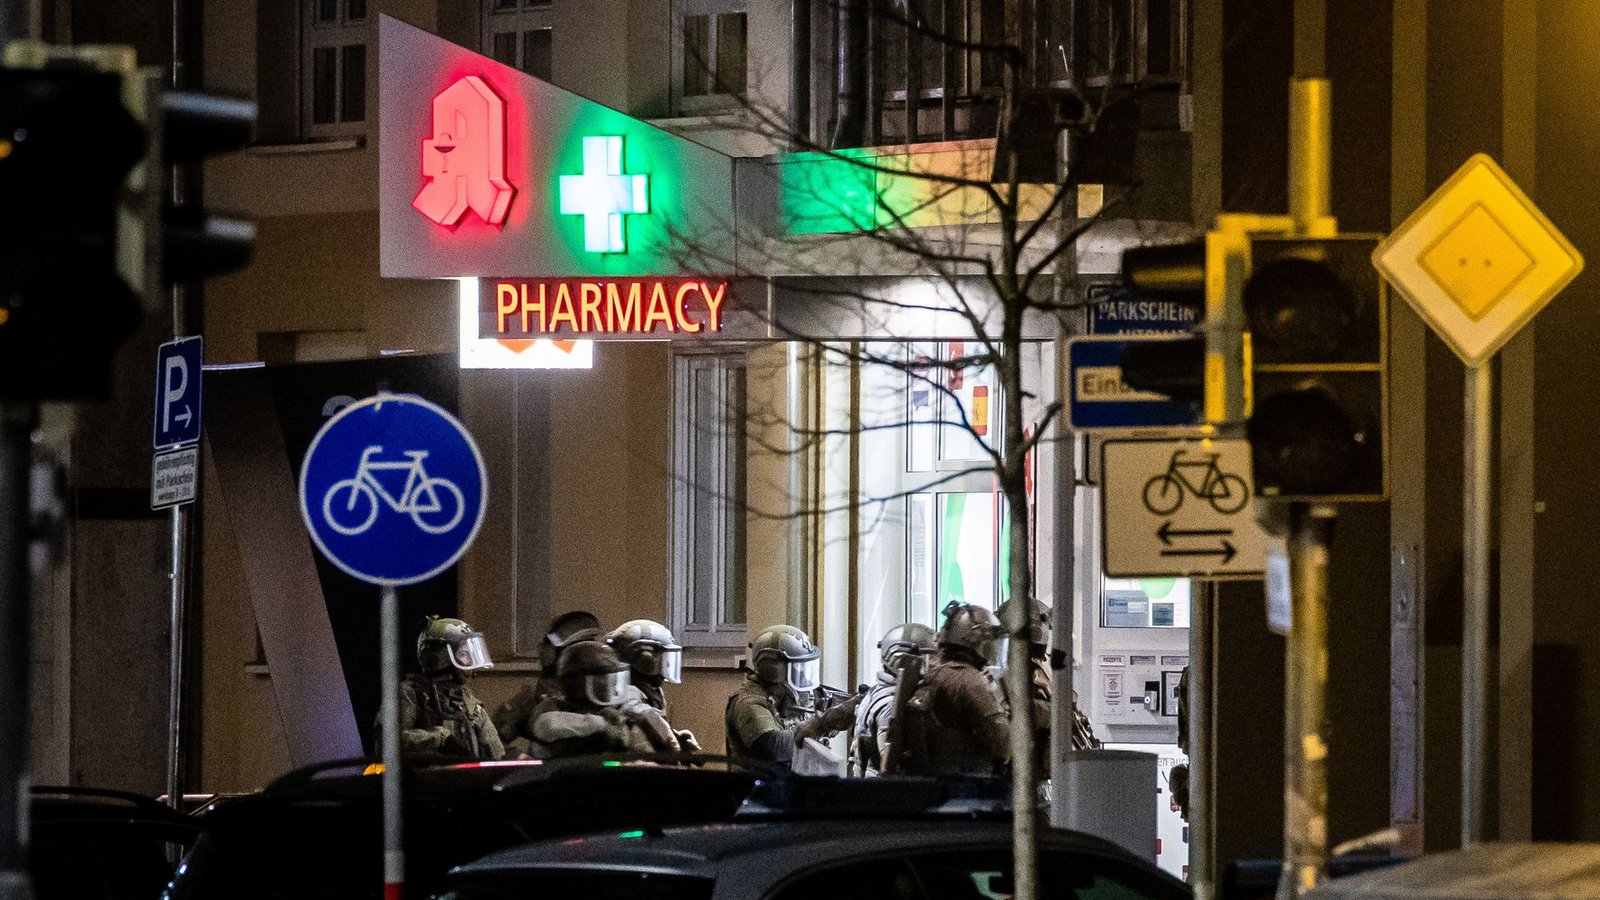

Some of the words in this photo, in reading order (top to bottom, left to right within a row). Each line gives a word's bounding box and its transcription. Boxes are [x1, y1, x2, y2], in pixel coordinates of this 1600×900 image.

[496, 281, 727, 334] PHARMACY
[1098, 301, 1196, 321] PARKSCHEIN
[162, 355, 189, 433] P
